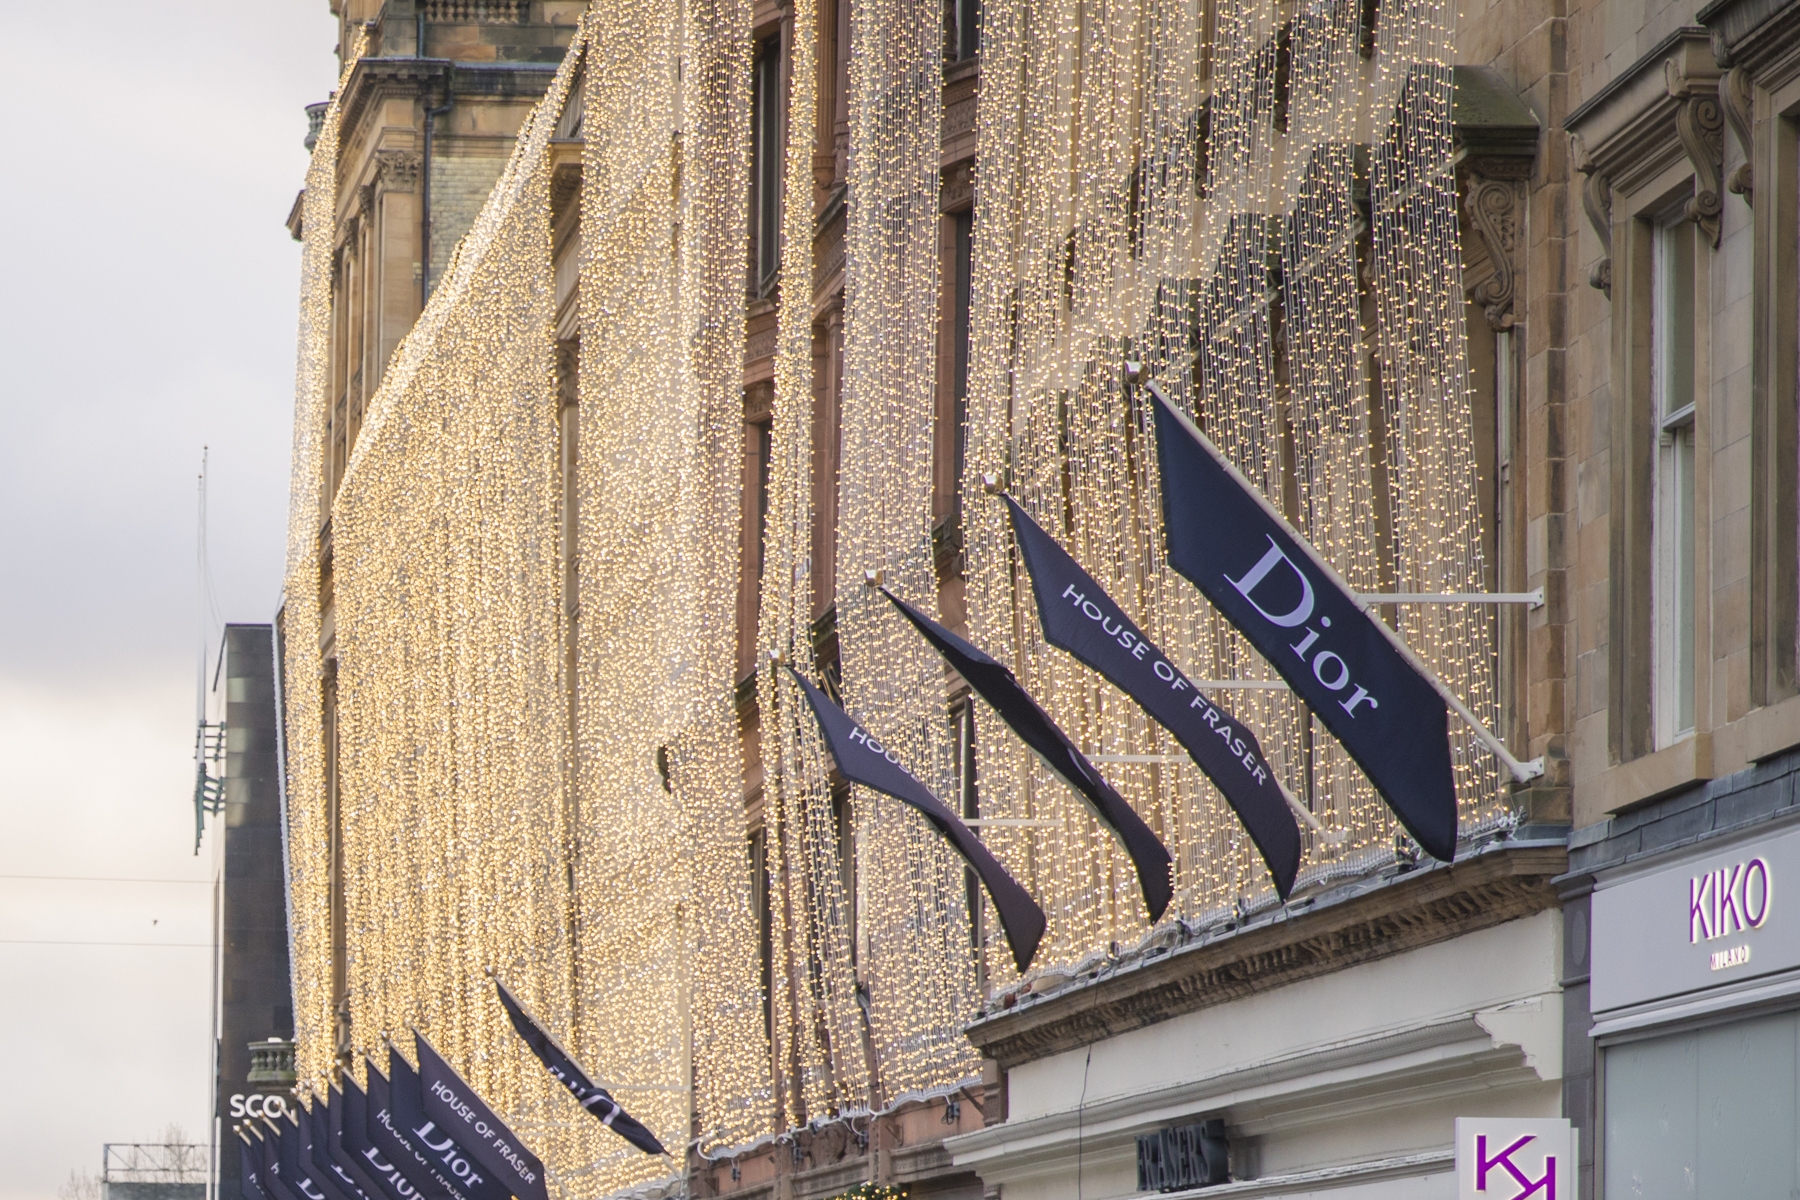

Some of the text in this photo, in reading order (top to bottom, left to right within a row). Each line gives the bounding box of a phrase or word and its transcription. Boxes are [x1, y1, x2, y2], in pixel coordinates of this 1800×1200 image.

[1223, 533, 1378, 718] Dior
[1062, 584, 1149, 661] HOUSE
[1153, 661, 1189, 691] OF
[1190, 695, 1267, 786] FRASER
[1689, 858, 1771, 945] KIKO
[1710, 945, 1749, 971] MILANO
[431, 1080, 536, 1184] HOUSE OF FRASER
[1135, 1122, 1209, 1191] FRASERS
